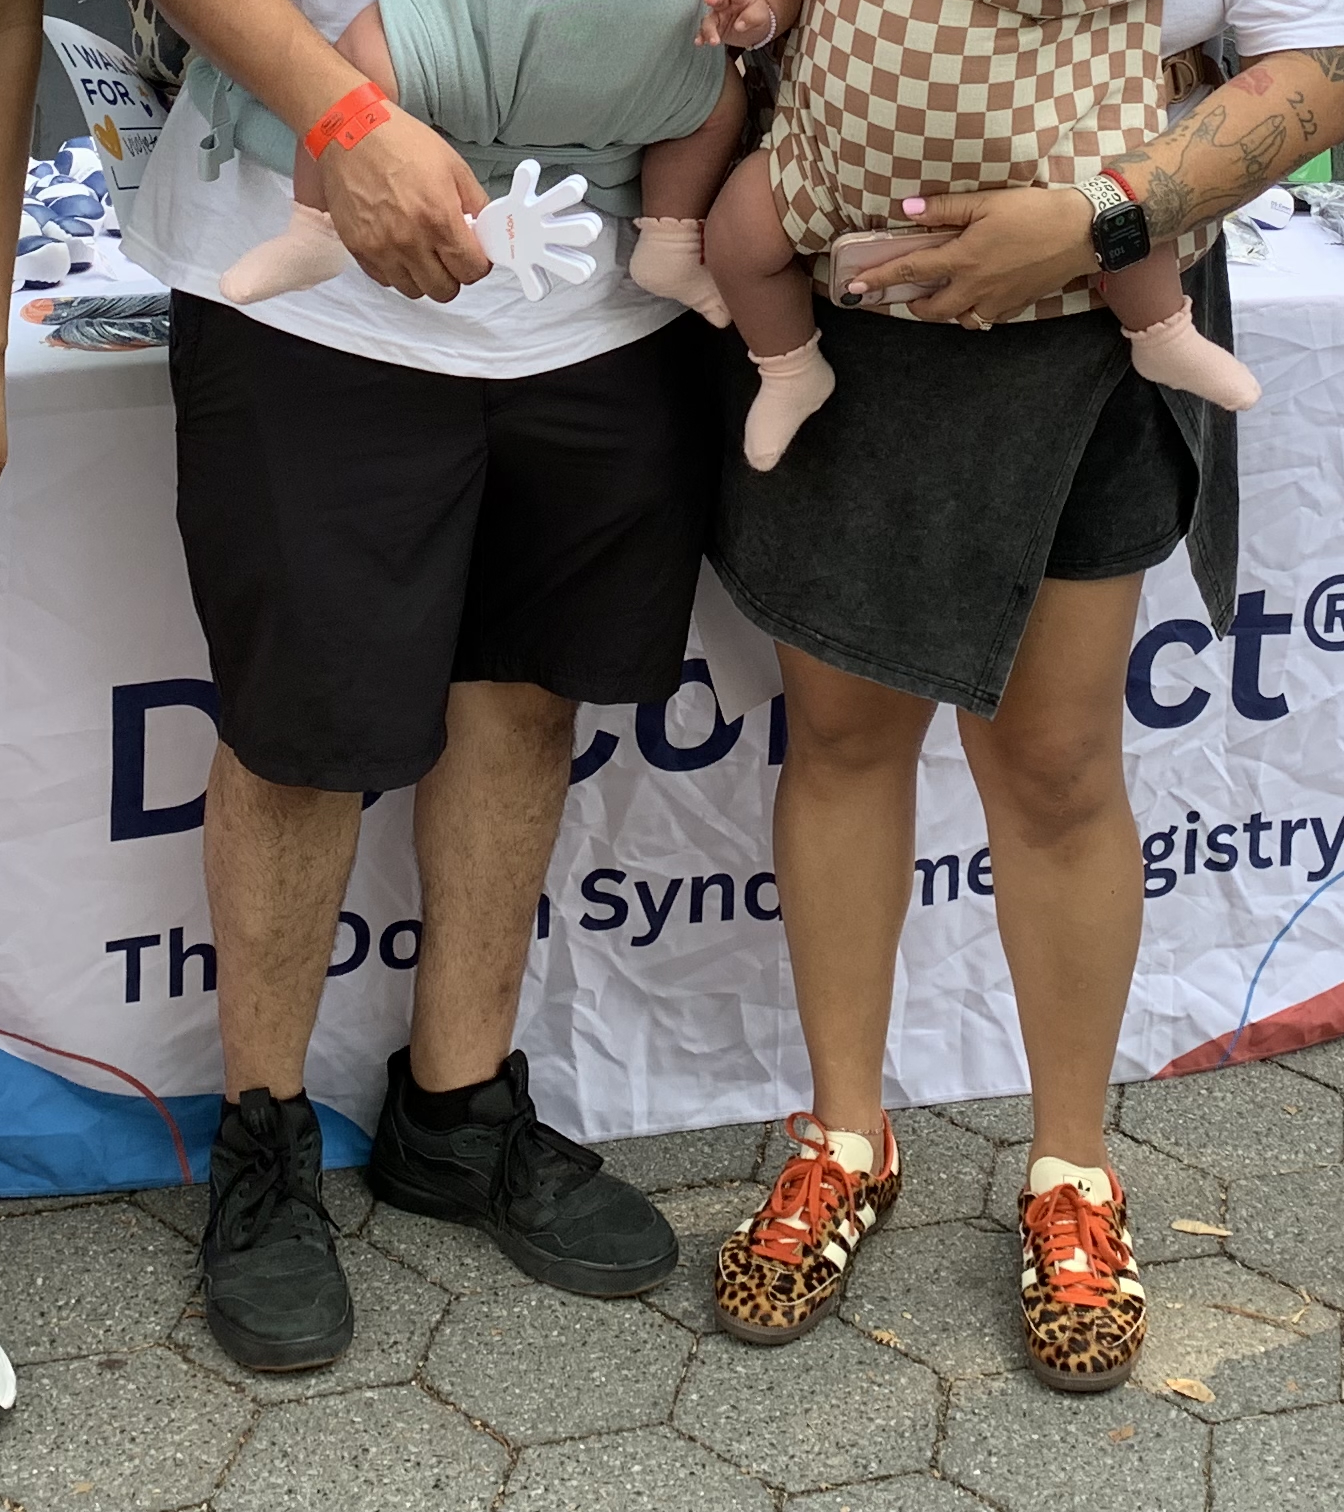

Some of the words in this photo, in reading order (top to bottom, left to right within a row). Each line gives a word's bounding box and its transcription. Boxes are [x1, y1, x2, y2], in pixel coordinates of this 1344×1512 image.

[60, 42, 78, 68] I
[80, 78, 136, 106] FOR
[365, 113, 378, 125] 2
[105, 928, 218, 1003] Th
[578, 845, 995, 948] Syndme
